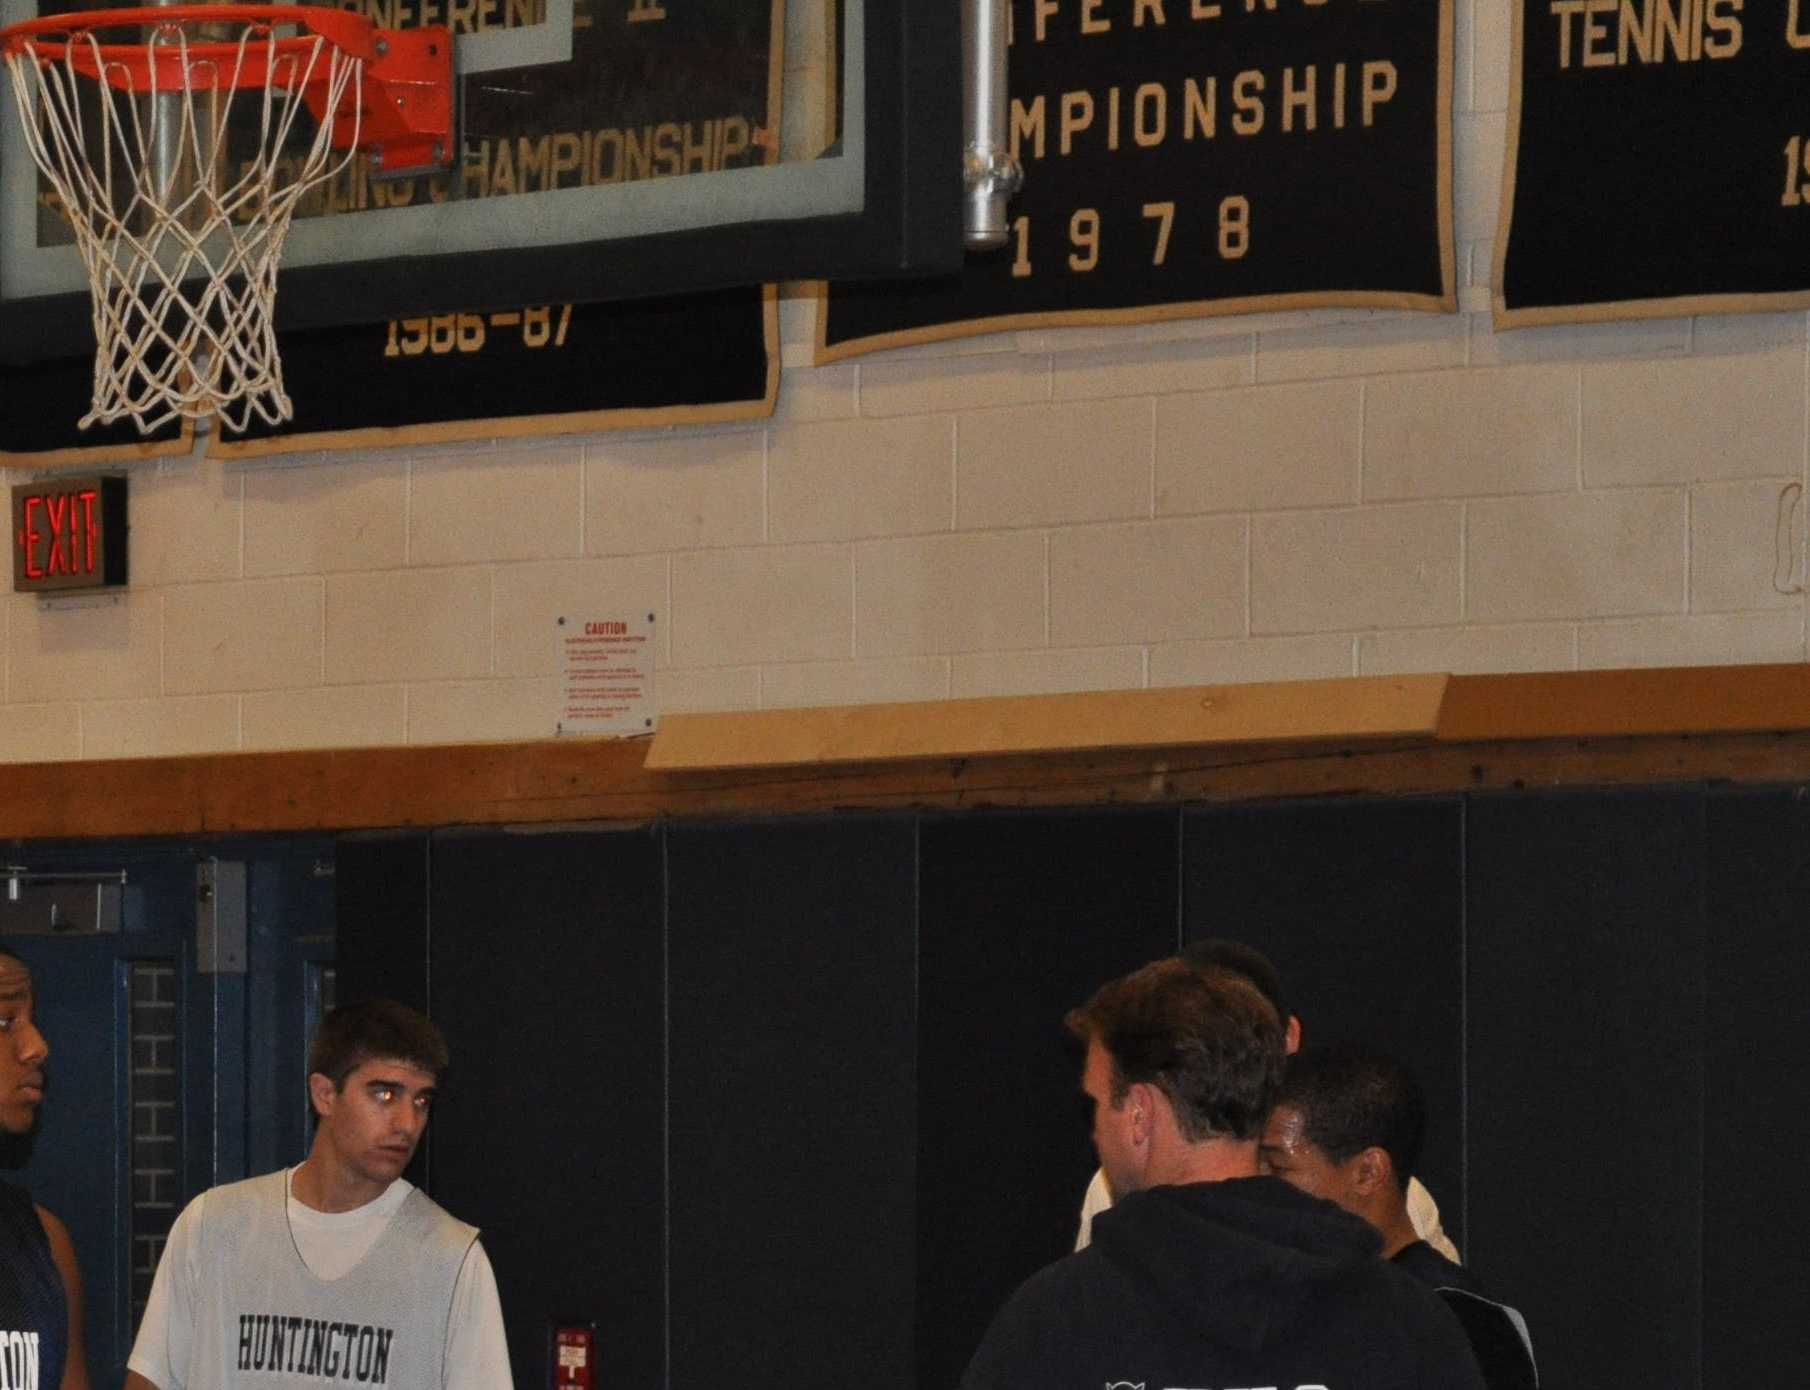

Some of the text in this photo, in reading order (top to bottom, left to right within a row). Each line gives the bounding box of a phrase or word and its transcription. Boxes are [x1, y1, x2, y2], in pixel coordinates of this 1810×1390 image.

[1550, 0, 1744, 69] TENNIS
[24, 490, 97, 579] EXIT
[585, 621, 627, 635] CAUTION
[237, 1314, 394, 1385] HUNTINGTON
